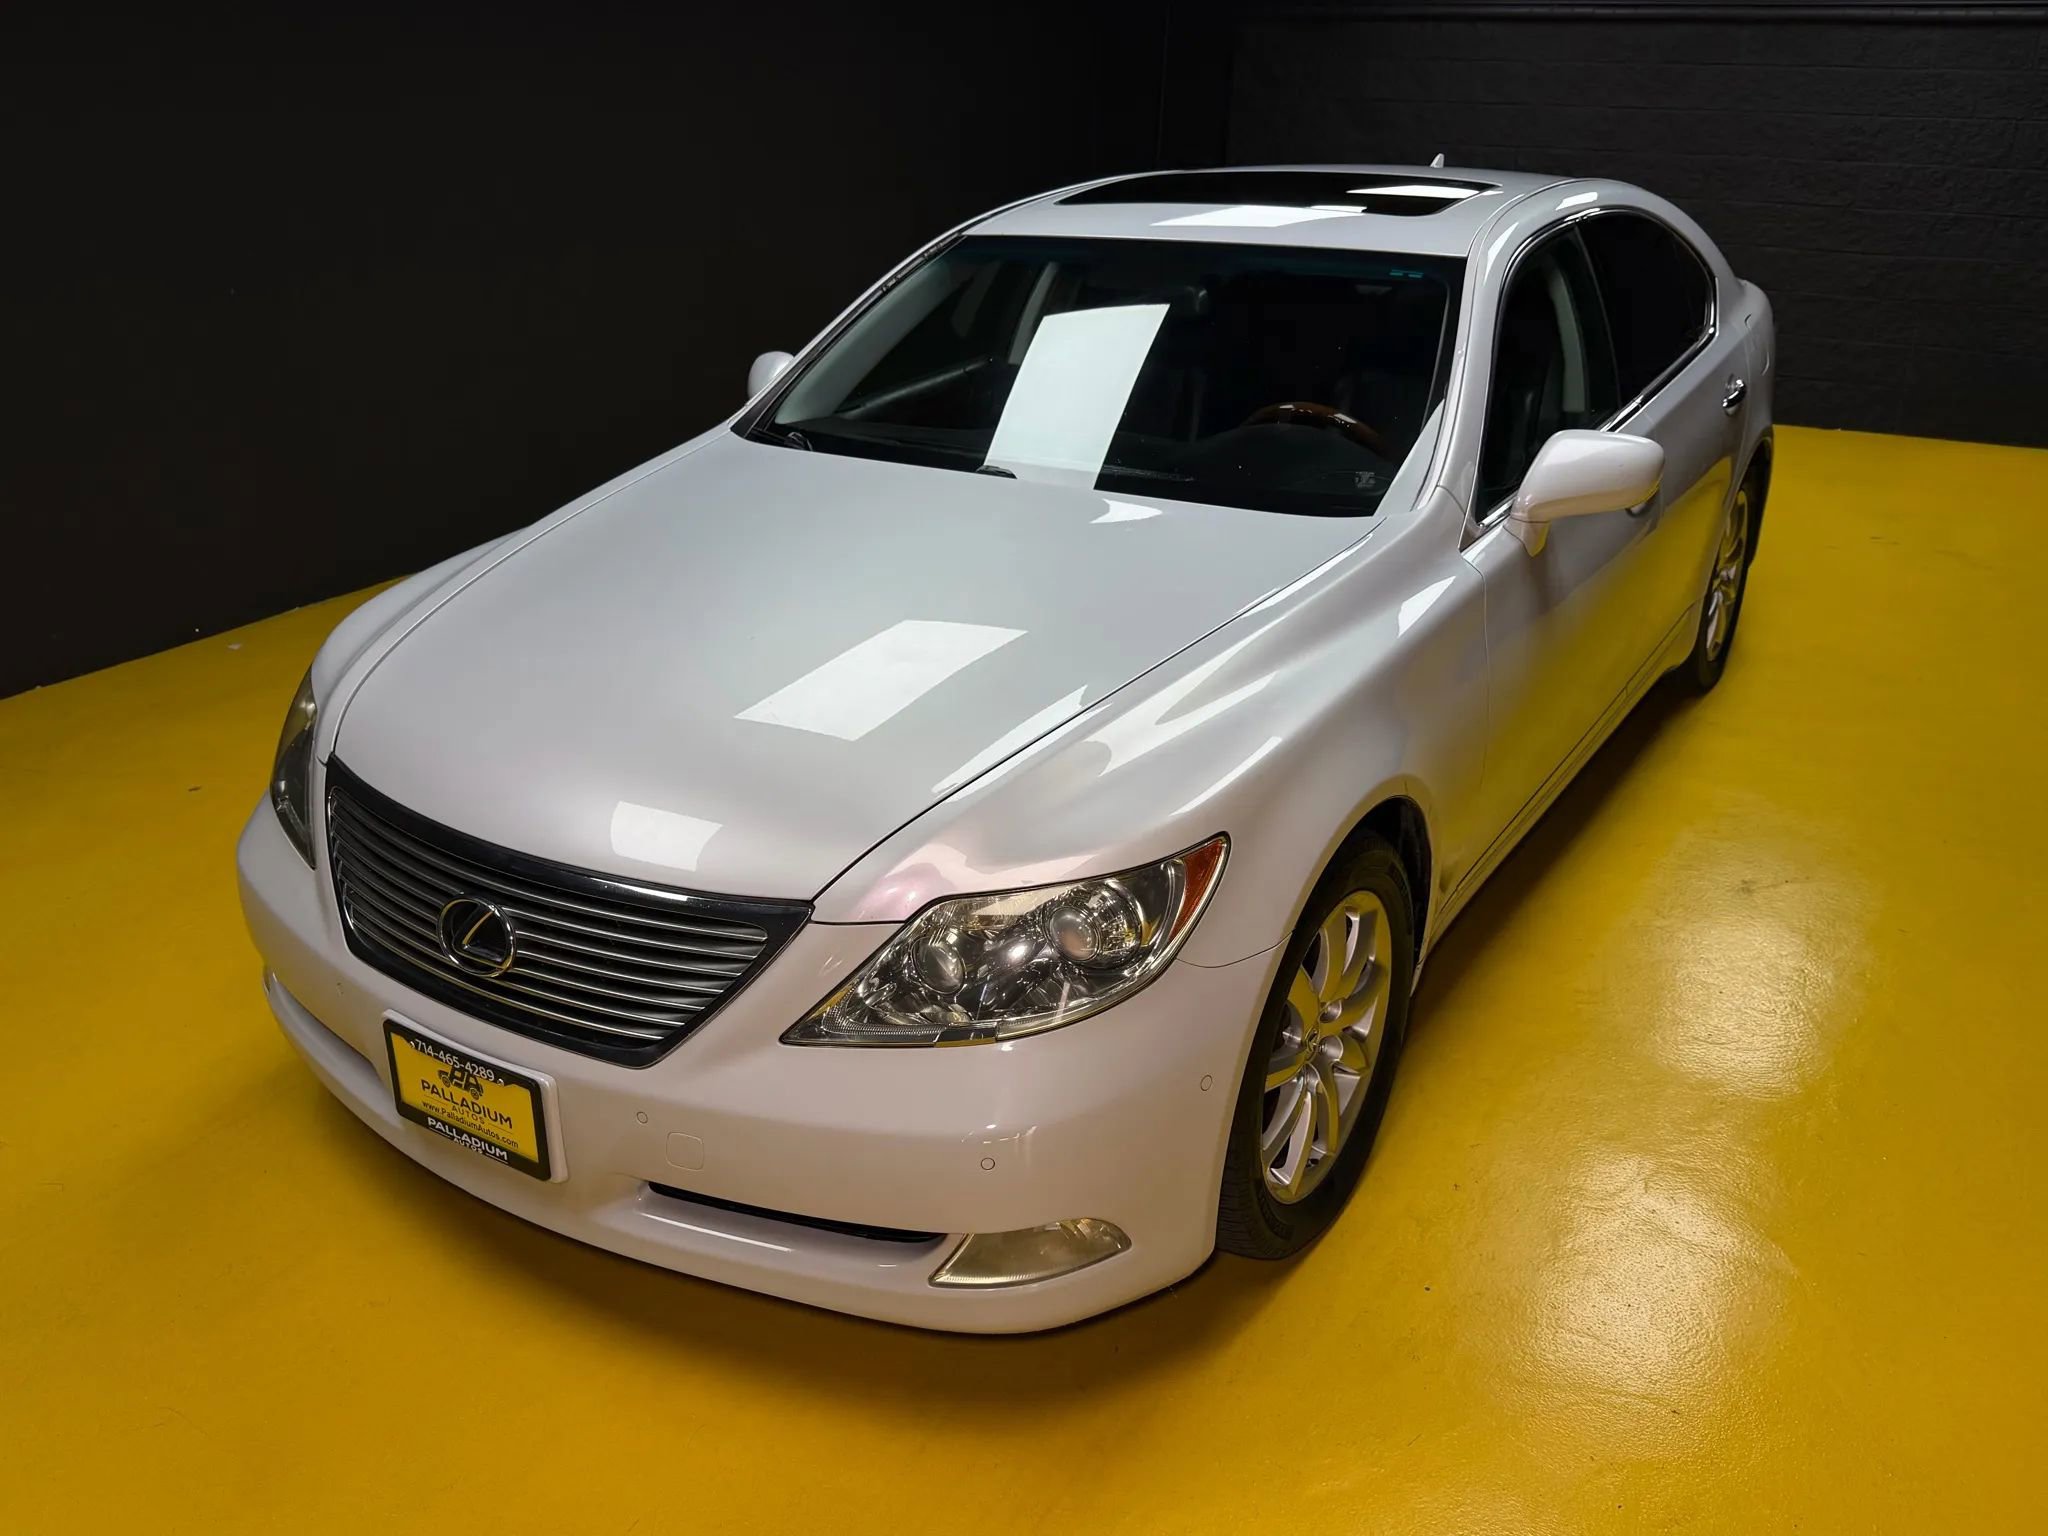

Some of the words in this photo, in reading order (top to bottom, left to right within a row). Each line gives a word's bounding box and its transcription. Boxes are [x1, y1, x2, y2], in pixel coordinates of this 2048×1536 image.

[416, 1039, 494, 1081] 714-465-4289
[421, 1079, 513, 1129] PALLADIUM
[422, 1101, 519, 1149] www.PalladiumAutos.com
[452, 1105, 485, 1125] AUTOS
[427, 1116, 508, 1160] PALLADIUM
[453, 1138, 483, 1154] AUTOS
